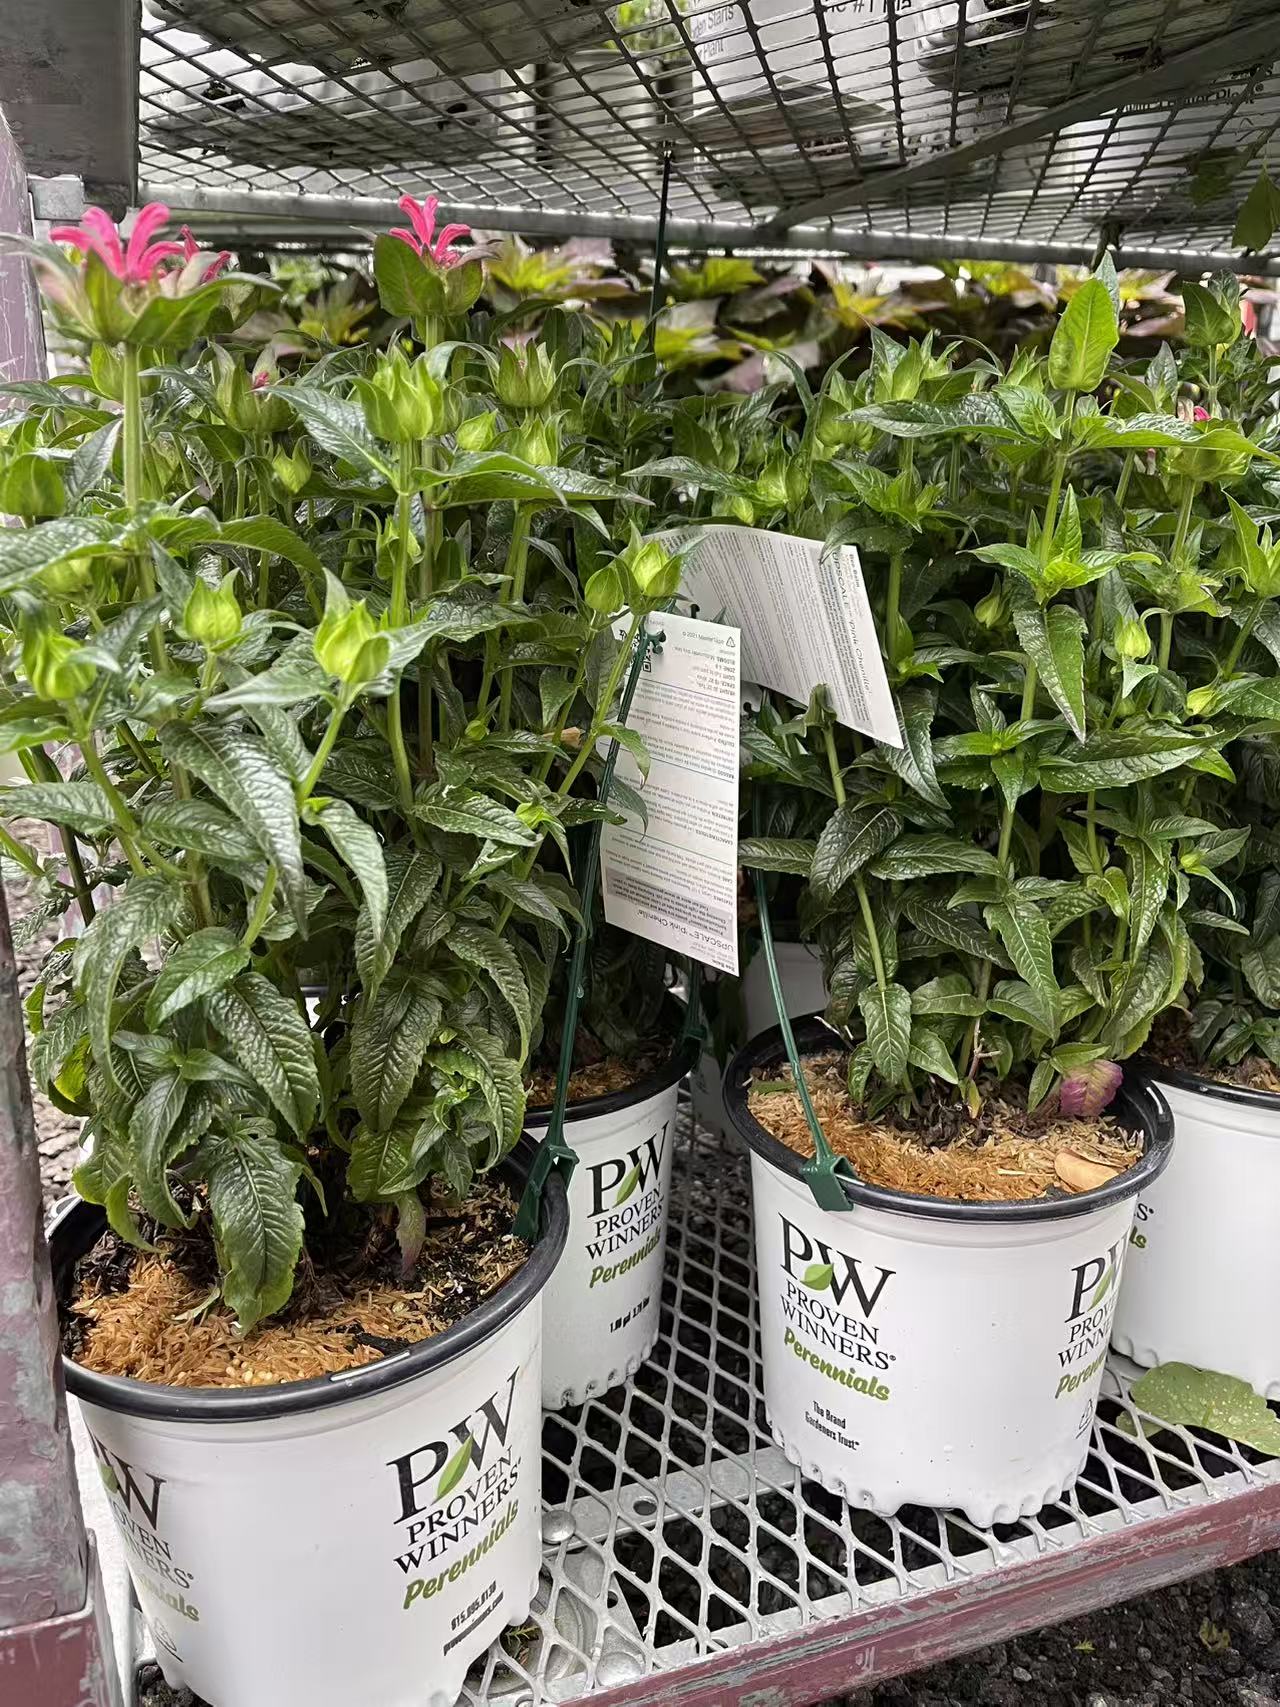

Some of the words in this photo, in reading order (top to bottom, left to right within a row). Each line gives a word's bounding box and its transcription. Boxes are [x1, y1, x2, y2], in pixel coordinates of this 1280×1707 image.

[585, 1120, 669, 1219] PW
[595, 1182, 663, 1238] PROVEN
[589, 1225, 661, 1288] Perennials
[778, 1212, 897, 1319] PW
[786, 1278, 879, 1345] PROVEN
[783, 1326, 890, 1401] Perennials
[386, 1365, 520, 1525] PW
[805, 1411, 836, 1440] Gardeners
[813, 1400, 824, 1417] The
[826, 1409, 846, 1429] Brand
[406, 1445, 513, 1547] PROVEN
[403, 1499, 519, 1610] Perennials
